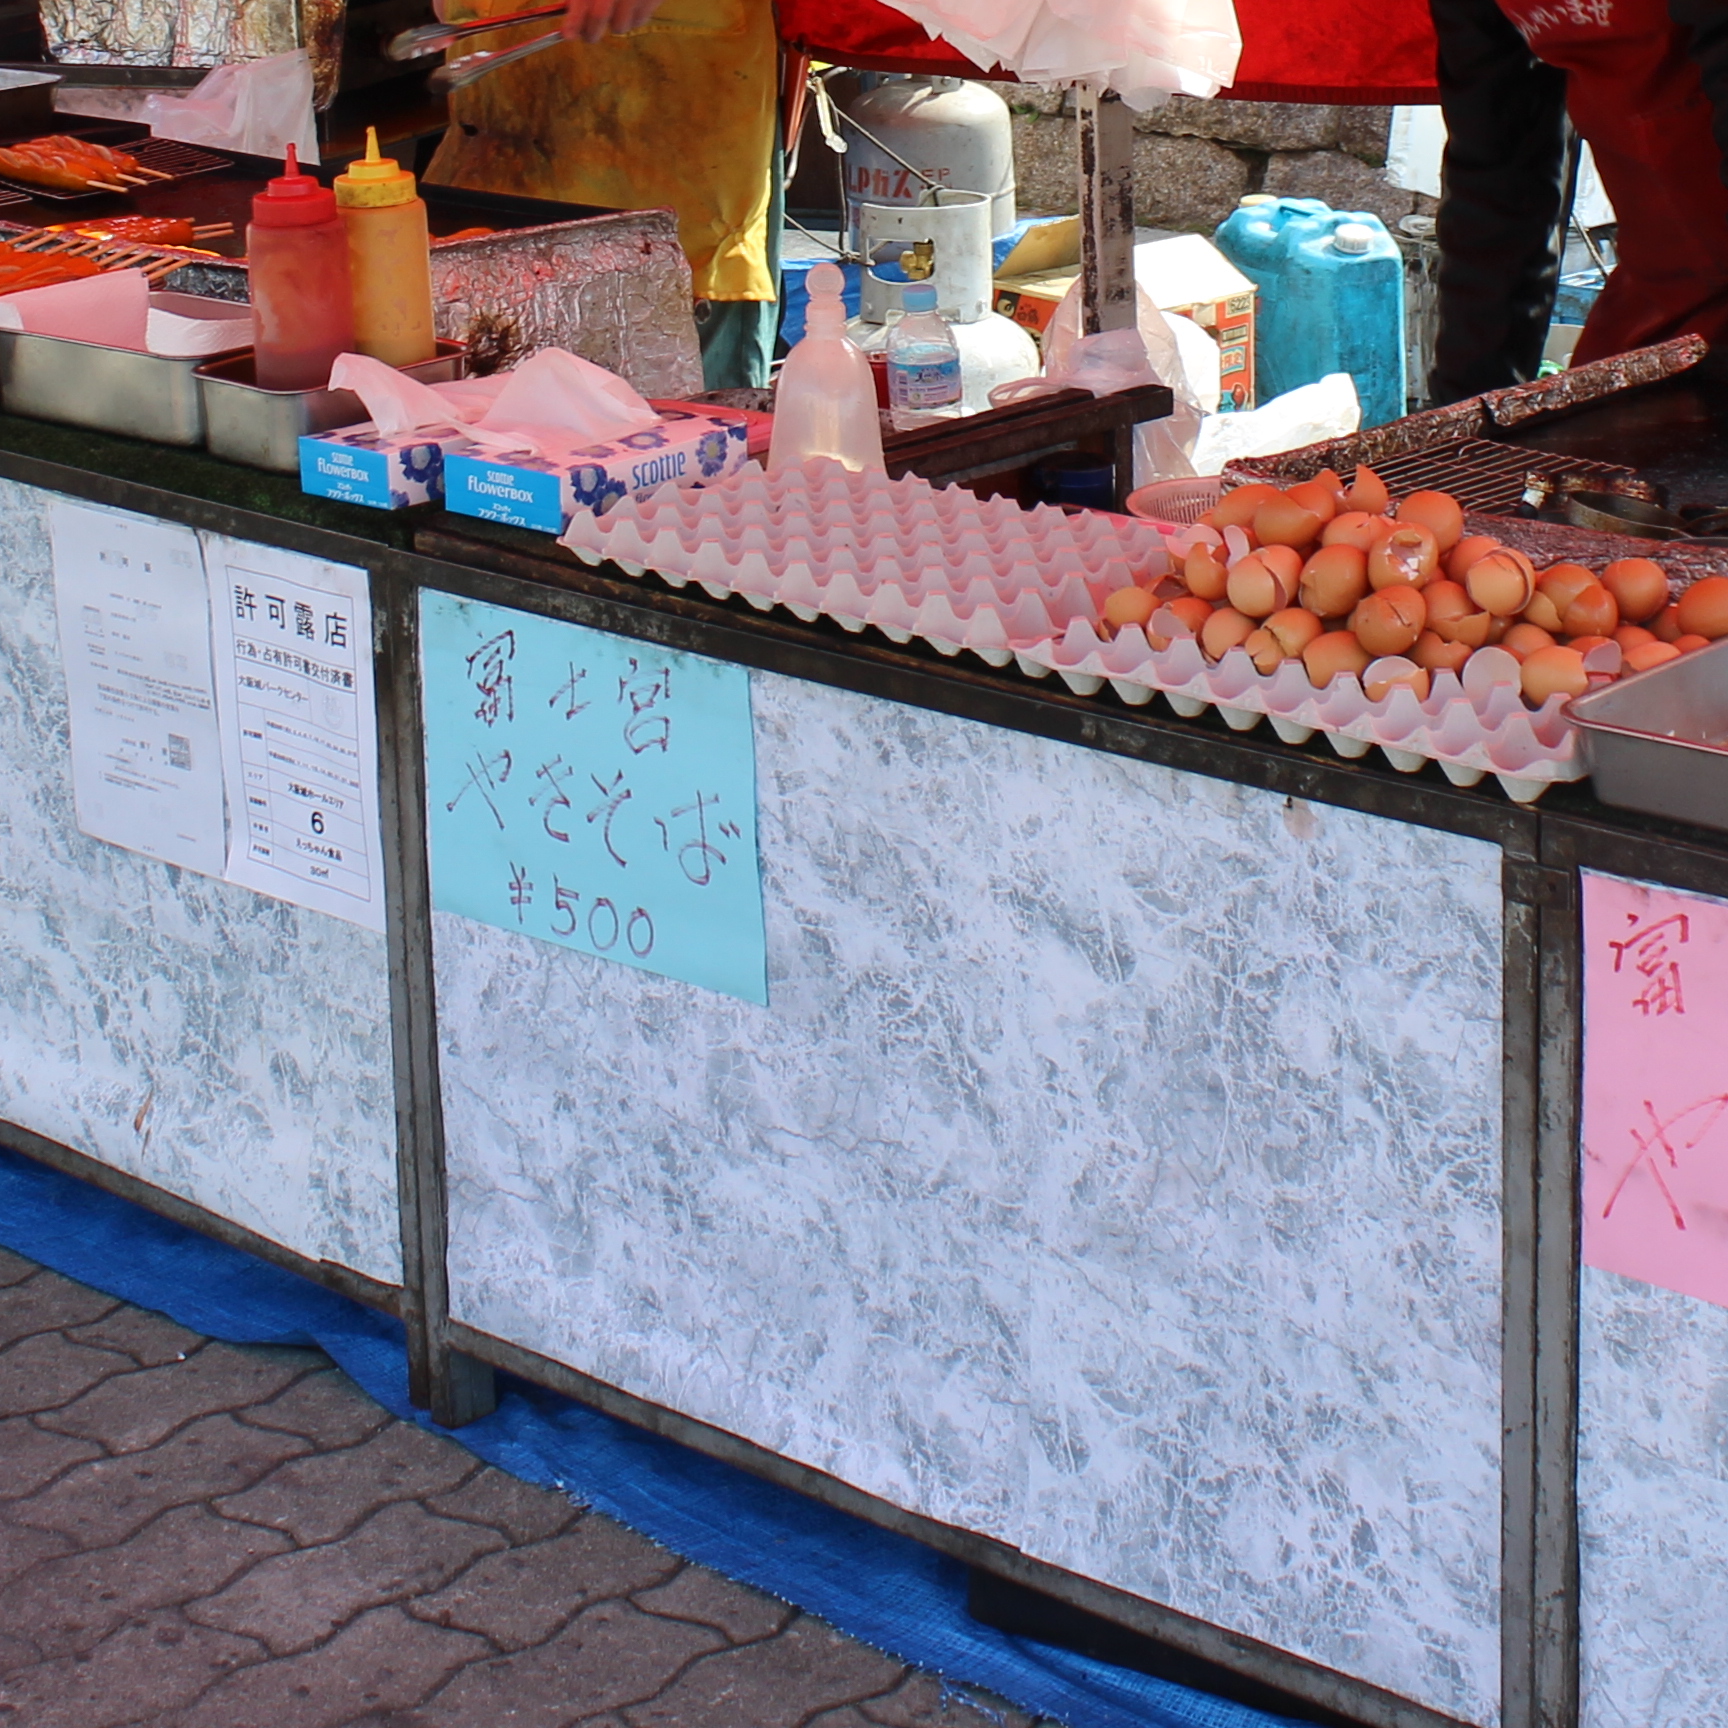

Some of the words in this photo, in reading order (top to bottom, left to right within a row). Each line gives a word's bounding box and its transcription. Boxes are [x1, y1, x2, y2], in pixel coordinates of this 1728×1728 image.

[234, 585, 347, 649] 許可露店
[311, 811, 325, 834] 6
[446, 749, 742, 886] やきそば
[509, 860, 654, 959] ¥500
